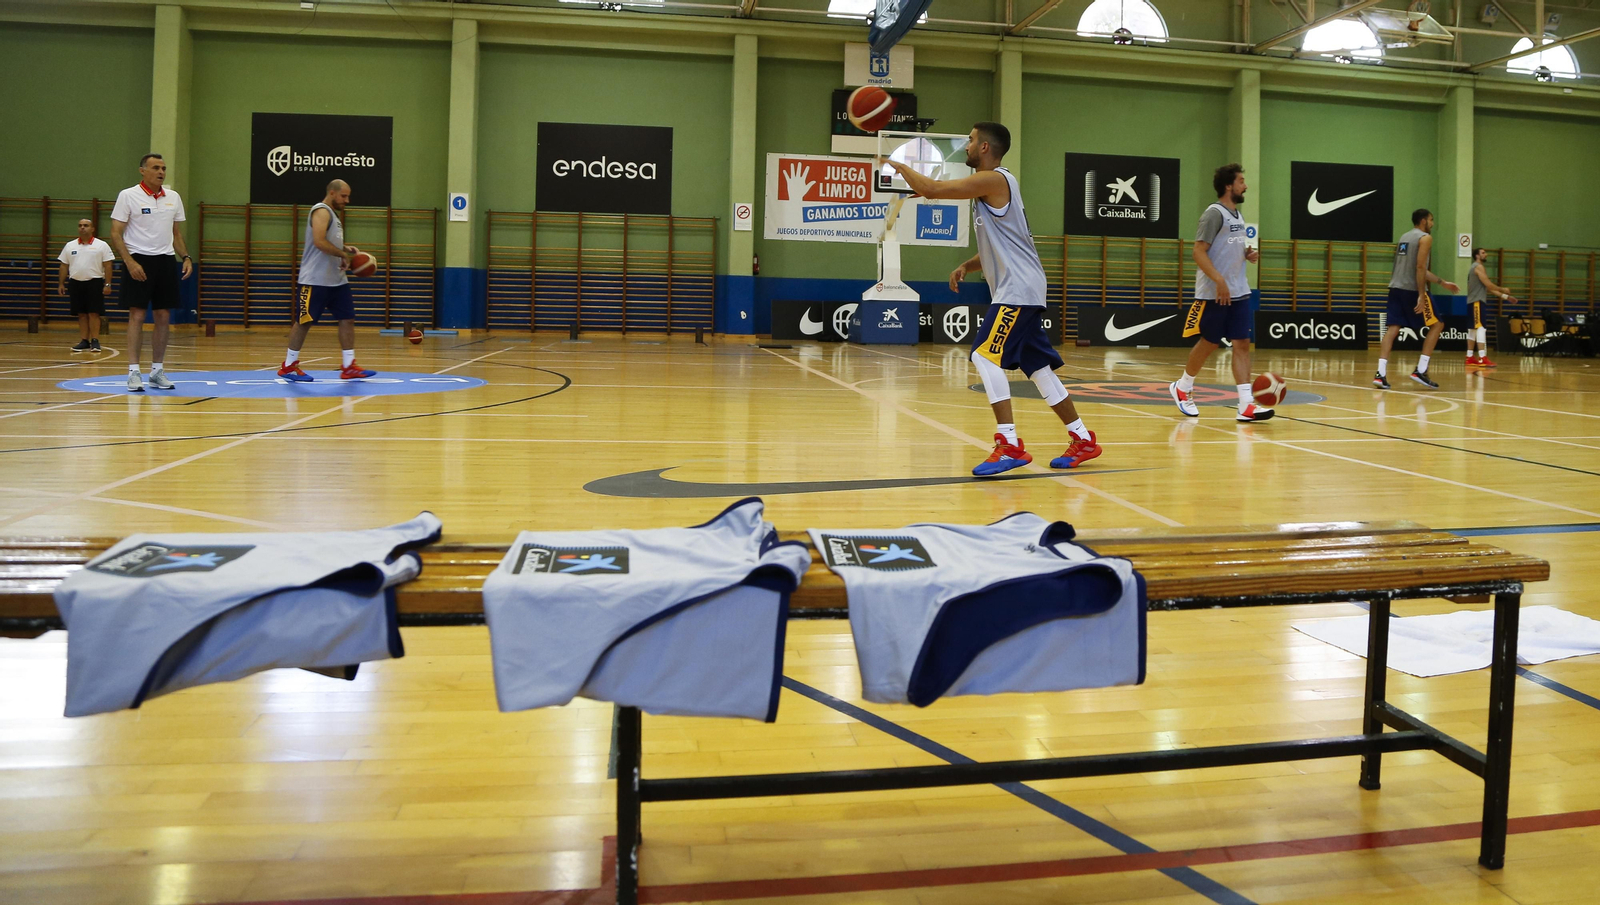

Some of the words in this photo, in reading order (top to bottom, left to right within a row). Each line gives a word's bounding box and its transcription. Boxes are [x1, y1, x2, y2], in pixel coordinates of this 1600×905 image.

[552, 155, 657, 180] endesa
[824, 166, 867, 182] JUEGA
[819, 182, 867, 199] LIMPIO
[457, 199, 462, 207] 1
[807, 206, 859, 220] GANAMOS
[861, 205, 888, 217] TODO
[1098, 206, 1147, 219] CaixaBank
[777, 227, 799, 235] JUEGOS
[835, 230, 873, 238] MUNICIPALES
[1248, 228, 1254, 236] 2
[1185, 300, 1203, 331] SPAÑA
[988, 306, 1019, 355] ESPAÑ
[1269, 318, 1356, 340] endesa
